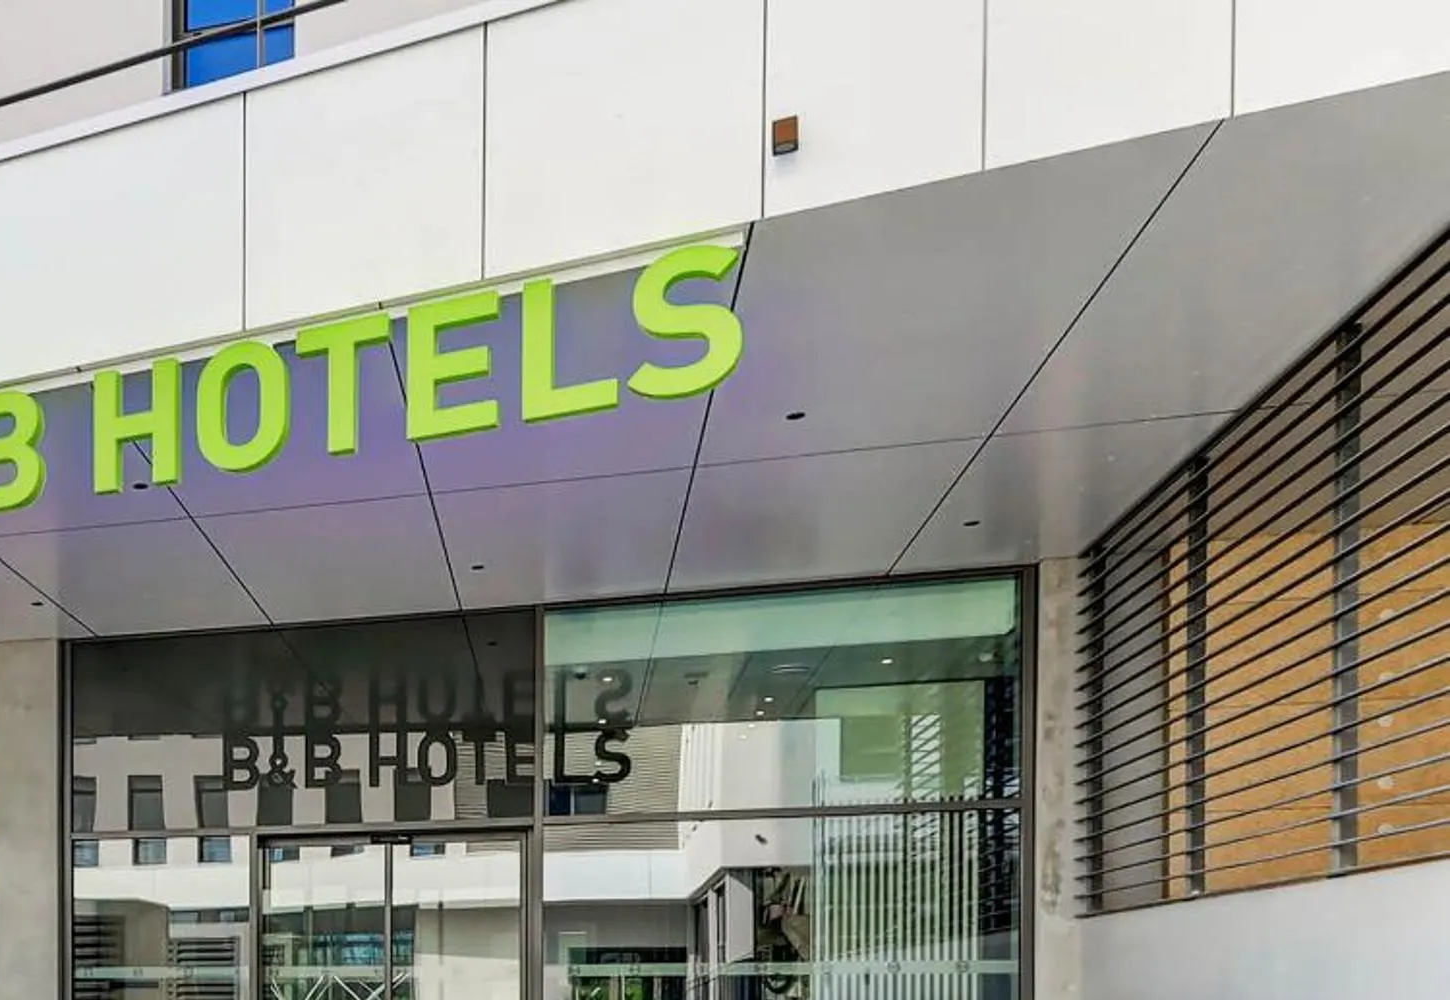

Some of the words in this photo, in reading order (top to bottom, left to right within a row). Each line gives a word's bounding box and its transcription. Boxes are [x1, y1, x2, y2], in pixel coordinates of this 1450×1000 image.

[91, 244, 744, 496] HOTELS
[223, 731, 342, 790] B&B
[370, 728, 632, 788] HOTELS
